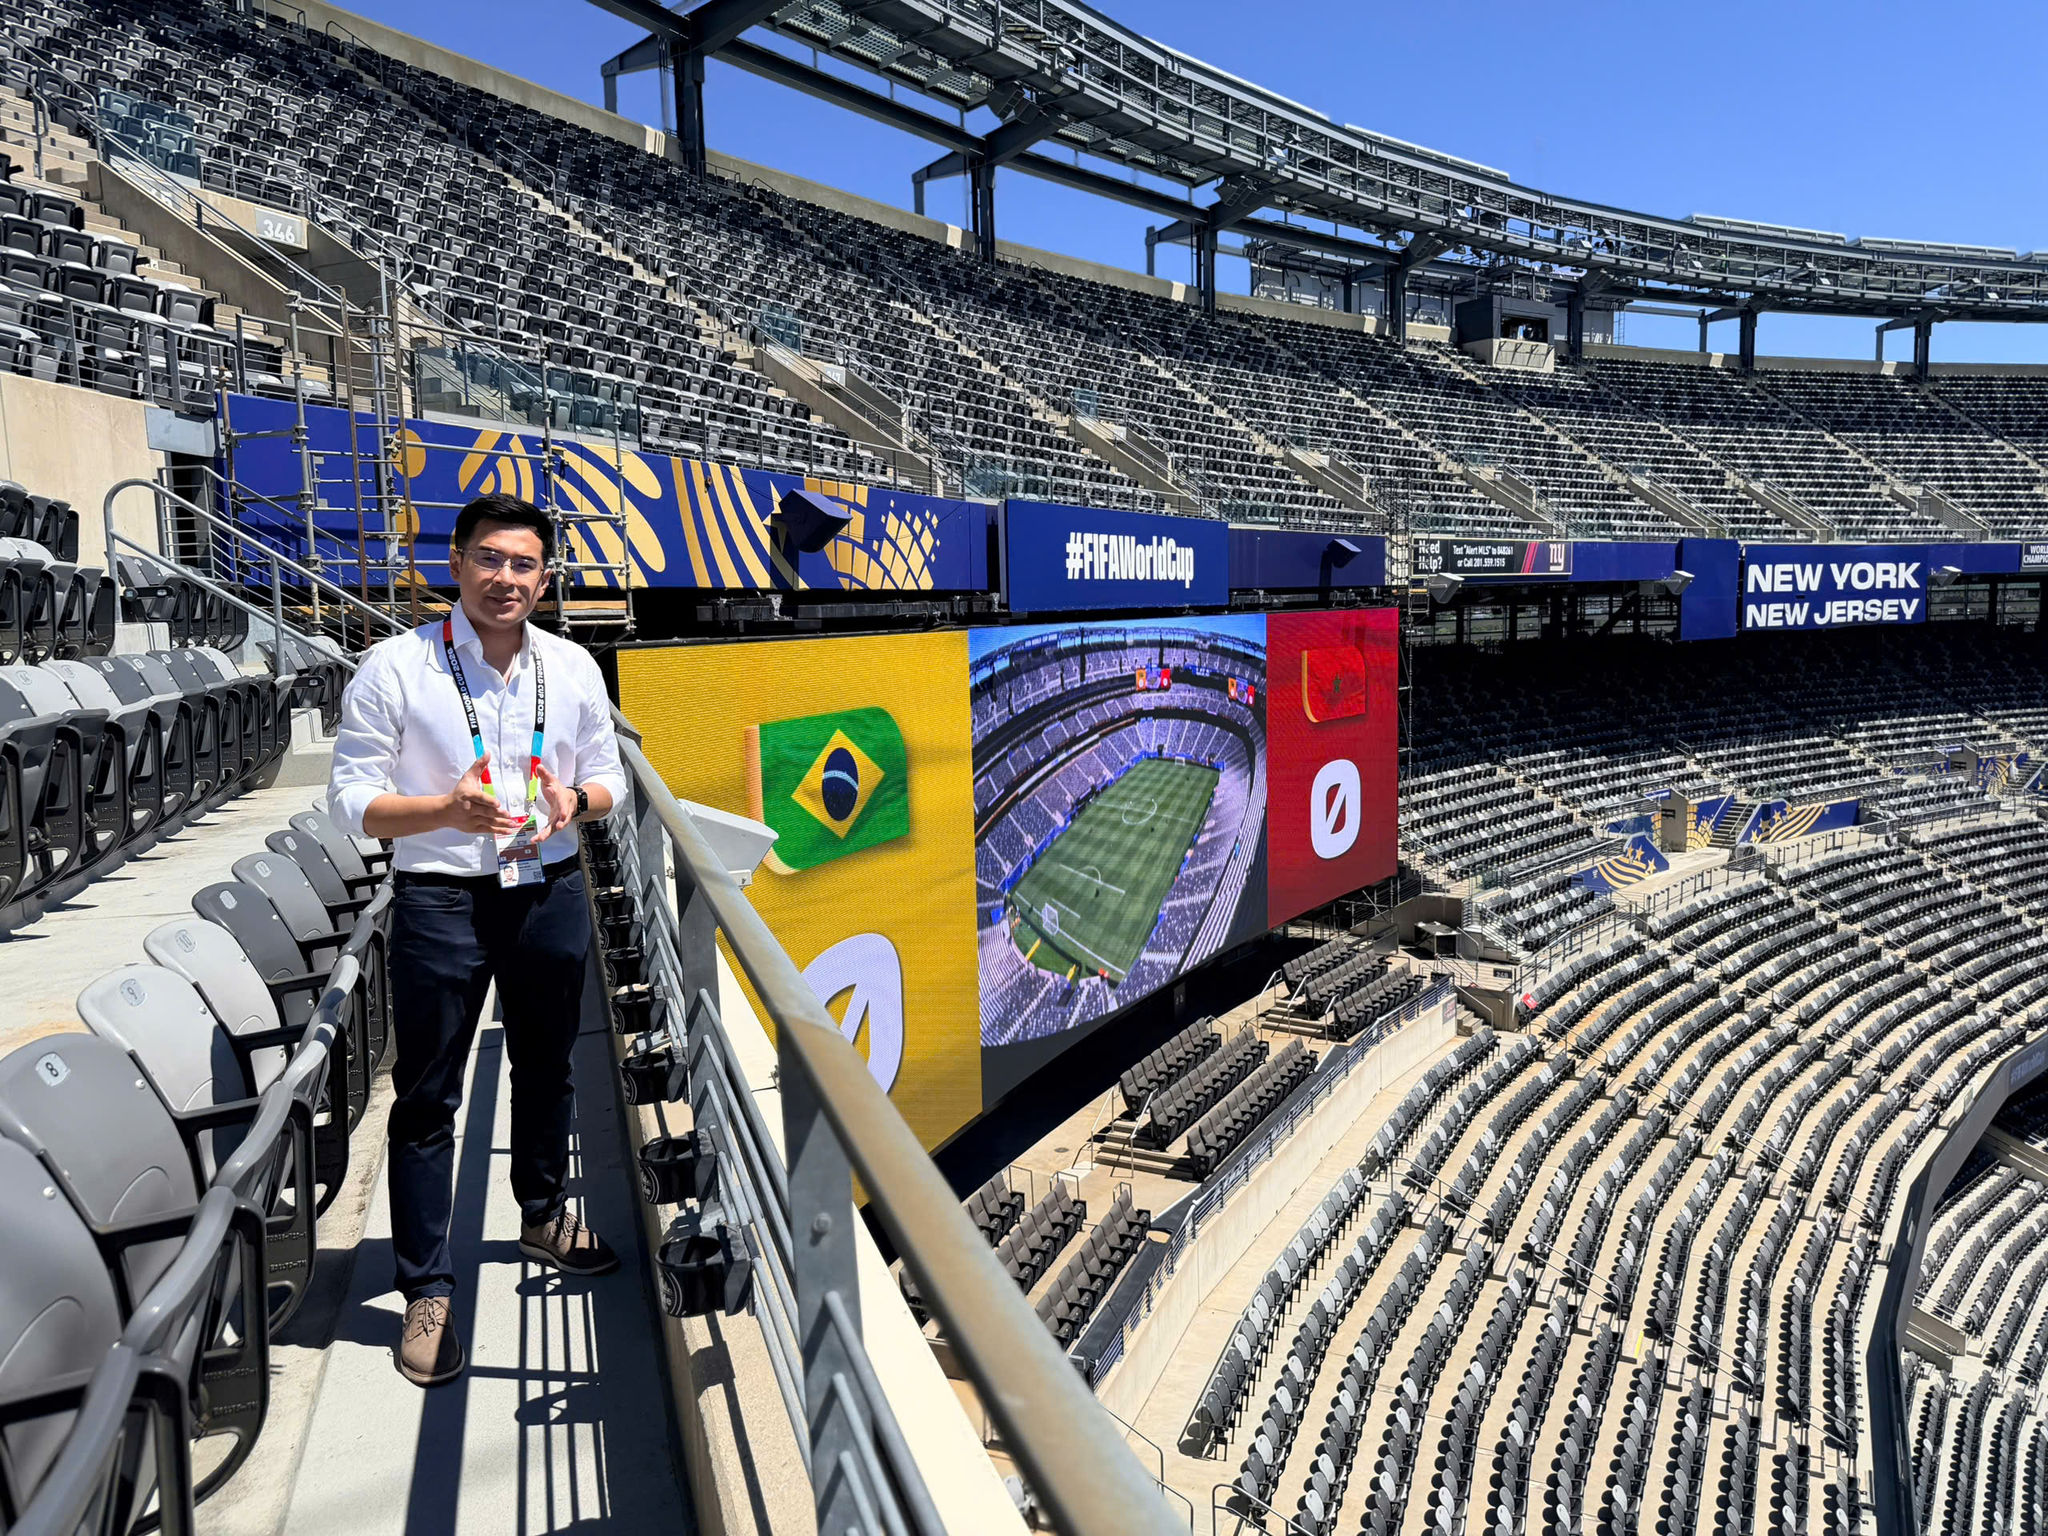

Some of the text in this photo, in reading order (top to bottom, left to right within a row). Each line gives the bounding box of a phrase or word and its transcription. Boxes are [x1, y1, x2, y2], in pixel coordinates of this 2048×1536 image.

[263, 219, 296, 244] 346
[1065, 531, 1195, 589] #FIFAWorldCup
[1747, 561, 1921, 593] NEW YORK
[1745, 598, 1920, 628] NEW JERSEY
[455, 672, 465, 686] CUP
[536, 660, 544, 684] WORLD
[460, 686, 473, 712] WORLD
[468, 711, 477, 728] FIFA
[1310, 758, 1362, 859] 0
[126, 986, 138, 1000] 9
[45, 1062, 59, 1077] 8
